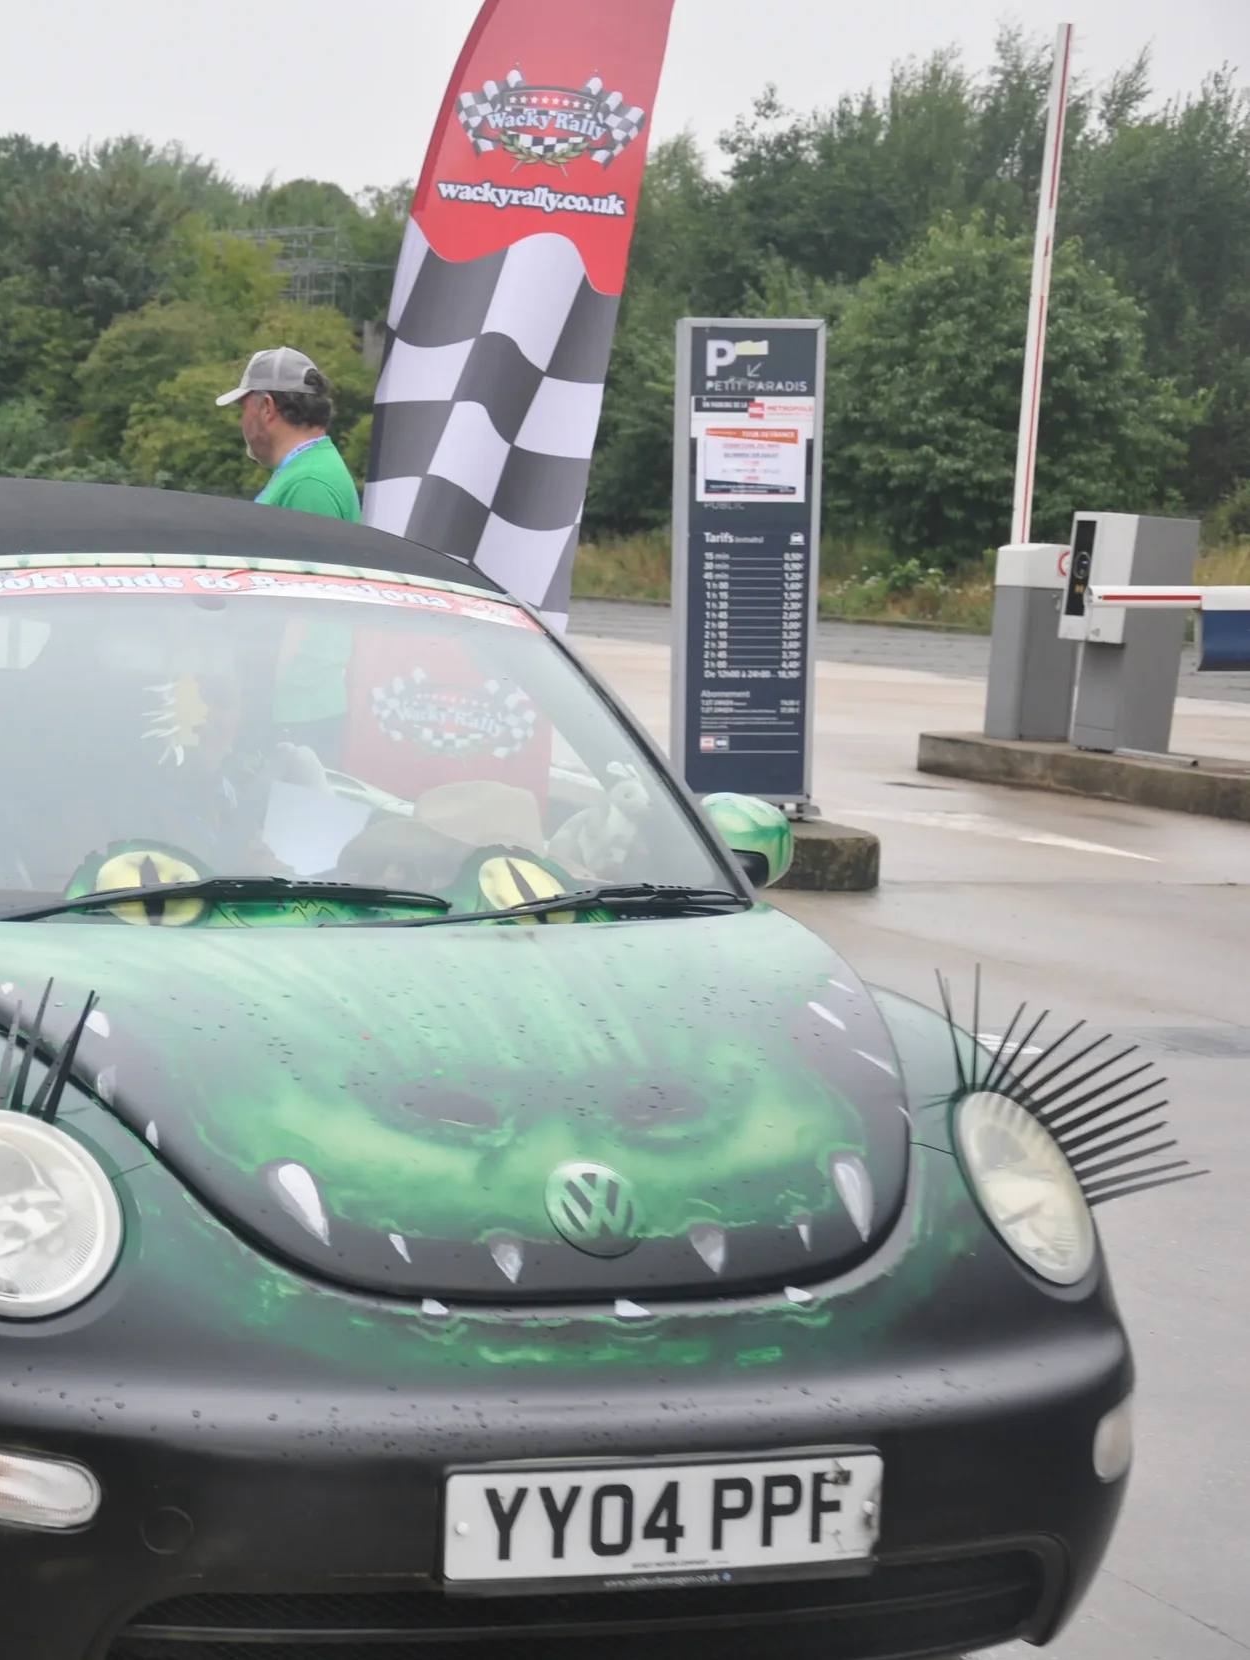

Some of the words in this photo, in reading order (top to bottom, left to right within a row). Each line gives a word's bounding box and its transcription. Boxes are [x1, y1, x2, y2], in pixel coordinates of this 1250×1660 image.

[486, 109, 551, 131] Wacky
[554, 112, 608, 140] Rally
[437, 181, 626, 216] wackyrally.co.uk
[706, 339, 737, 377] P
[705, 380, 742, 392] PETIT
[747, 380, 808, 392] PARADIS
[703, 531, 734, 544] Tarifs
[704, 552, 714, 560] 15
[714, 552, 730, 560] min
[704, 562, 714, 570] 30
[714, 562, 730, 570] min
[193, 573, 242, 591] to
[703, 572, 714, 580] 45
[714, 572, 730, 580] min
[704, 670, 716, 678] De
[700, 690, 750, 698] Abonnement
[483, 1480, 685, 1561] YY04
[711, 1469, 854, 1551] PPF
